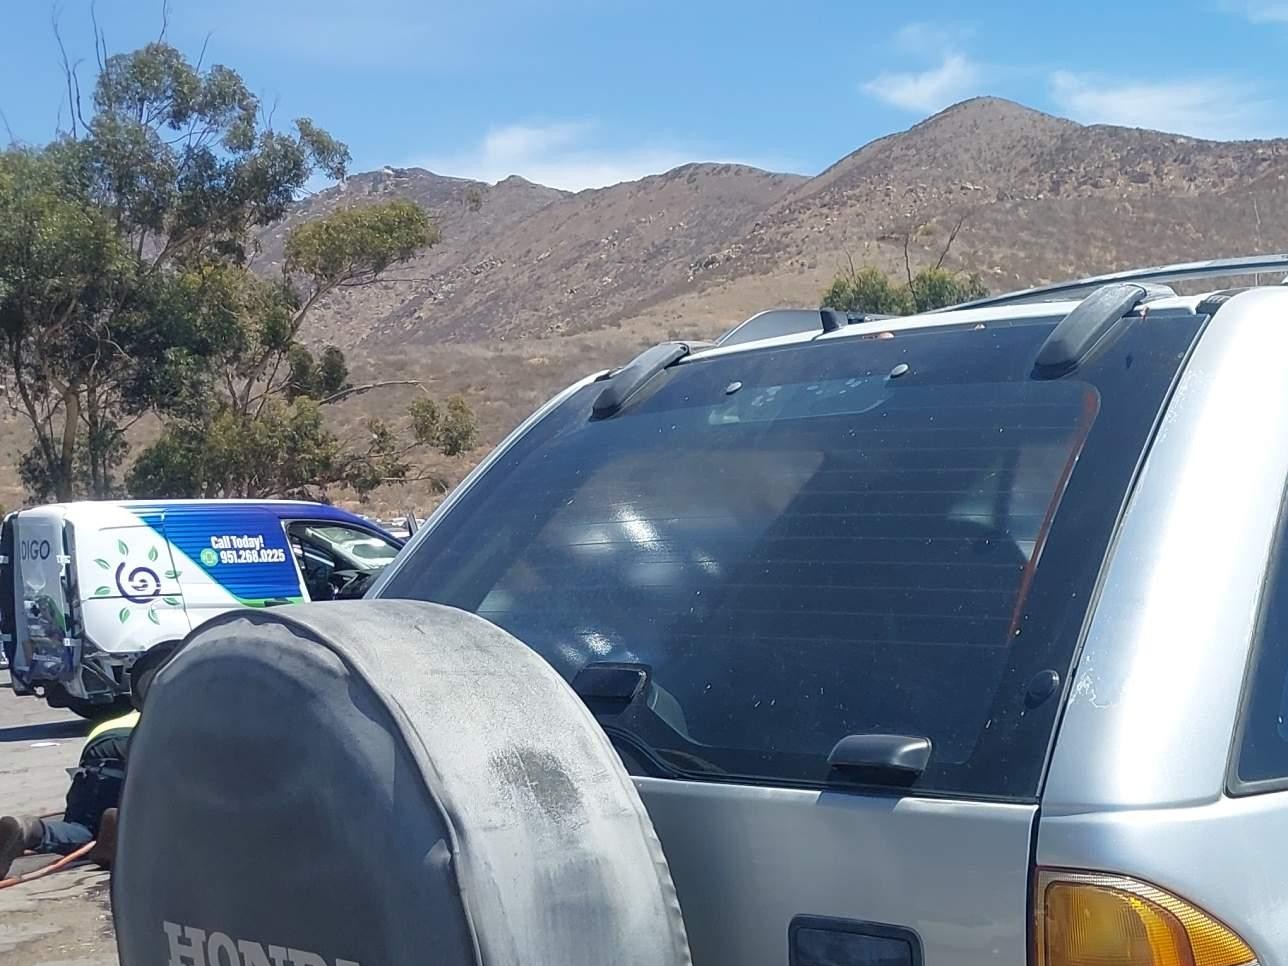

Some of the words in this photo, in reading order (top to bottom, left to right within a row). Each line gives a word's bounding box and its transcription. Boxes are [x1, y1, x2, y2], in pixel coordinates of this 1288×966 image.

[211, 536, 231, 549] Call
[230, 535, 264, 550] Today!
[220, 549, 286, 564] 951.268.0225
